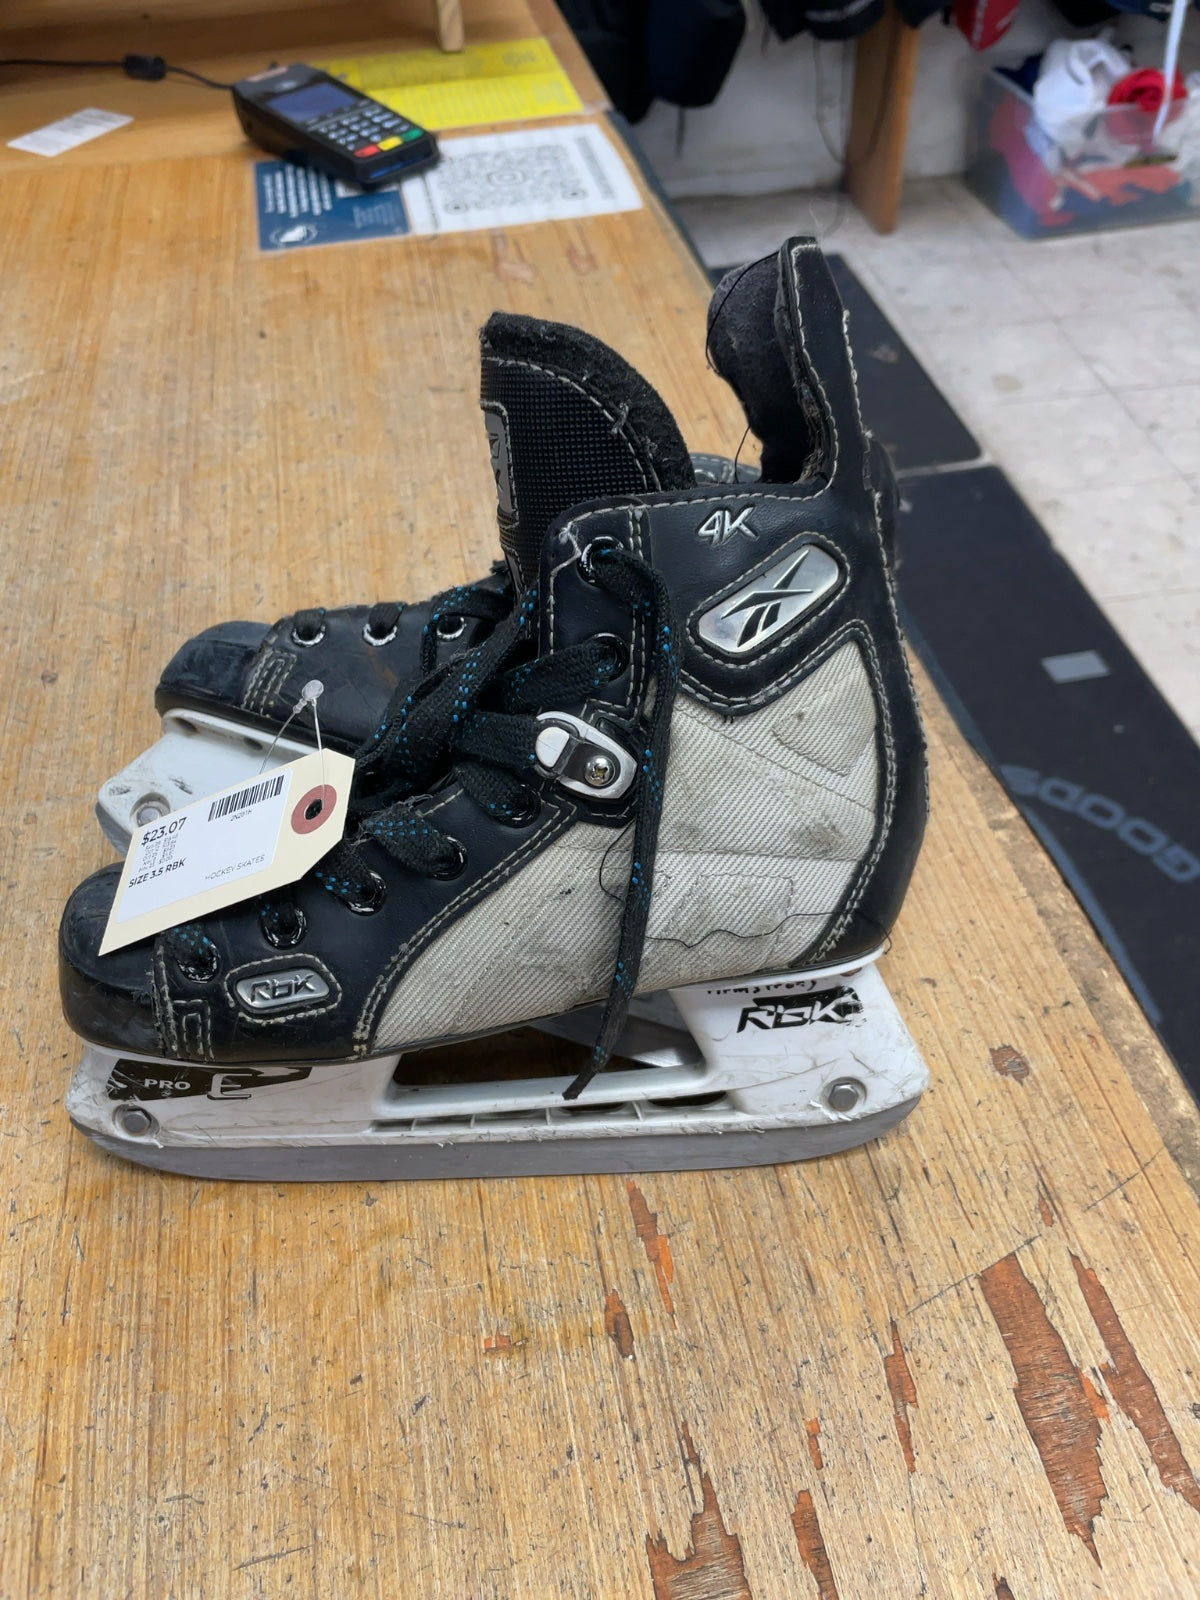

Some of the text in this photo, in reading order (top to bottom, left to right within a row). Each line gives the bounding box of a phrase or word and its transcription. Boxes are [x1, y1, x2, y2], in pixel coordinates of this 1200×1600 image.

[697, 505, 757, 545] 4K
[141, 816, 187, 847] $23.07
[128, 872, 149, 888] SIZE
[149, 866, 164, 880] 3.5
[165, 857, 187, 873] RBK
[204, 854, 265, 880] HOCKEY SKATES
[144, 1078, 191, 1091] PRO
